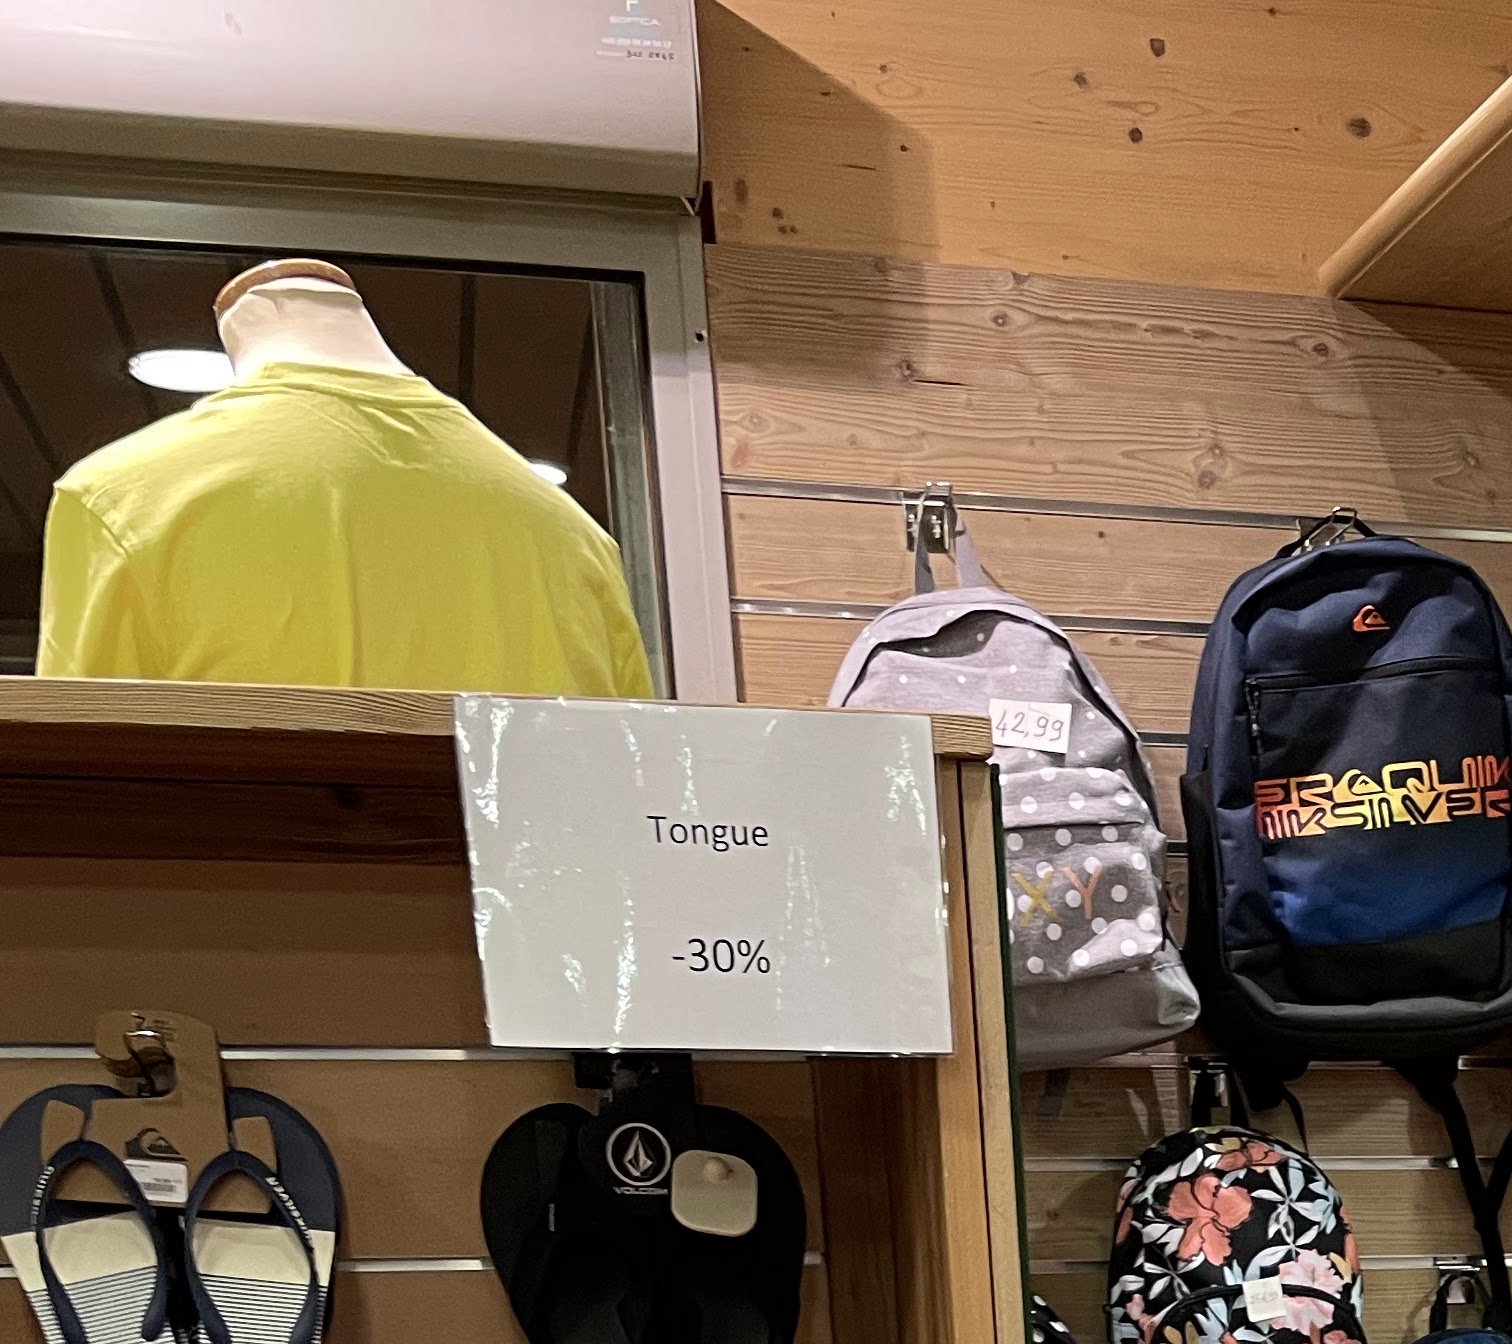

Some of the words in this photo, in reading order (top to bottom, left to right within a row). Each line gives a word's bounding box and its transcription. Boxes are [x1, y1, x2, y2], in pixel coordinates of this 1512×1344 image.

[995, 709, 1065, 742] 42,99
[647, 815, 769, 852] Tongue
[672, 938, 771, 974] -30%
